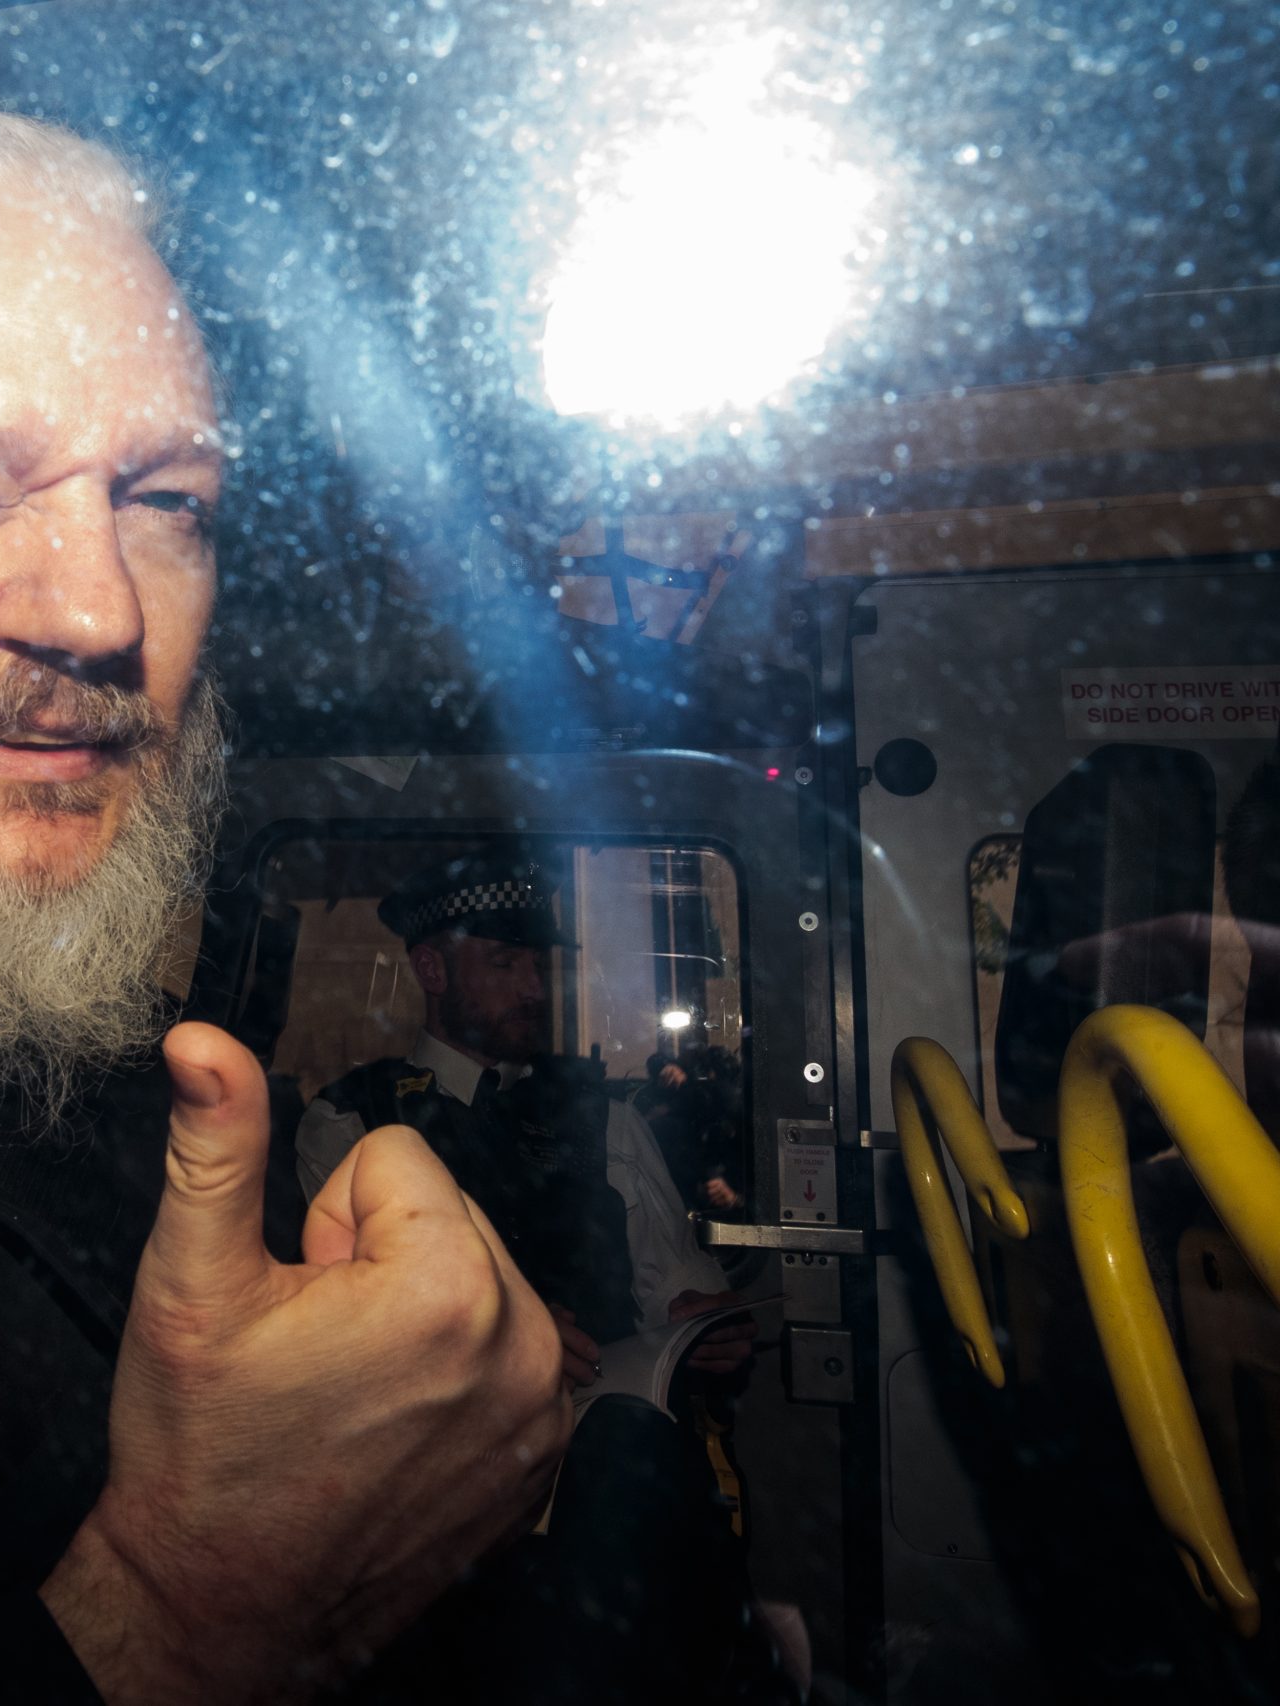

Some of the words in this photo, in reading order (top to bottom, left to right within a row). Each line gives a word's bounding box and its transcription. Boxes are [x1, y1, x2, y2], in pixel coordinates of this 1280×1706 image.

[1071, 684, 1103, 700] DO
[1111, 683, 1159, 699] NOT
[1166, 682, 1237, 698] DRIVE
[1088, 708, 1141, 724] SIDE
[1148, 707, 1217, 723] DOOR
